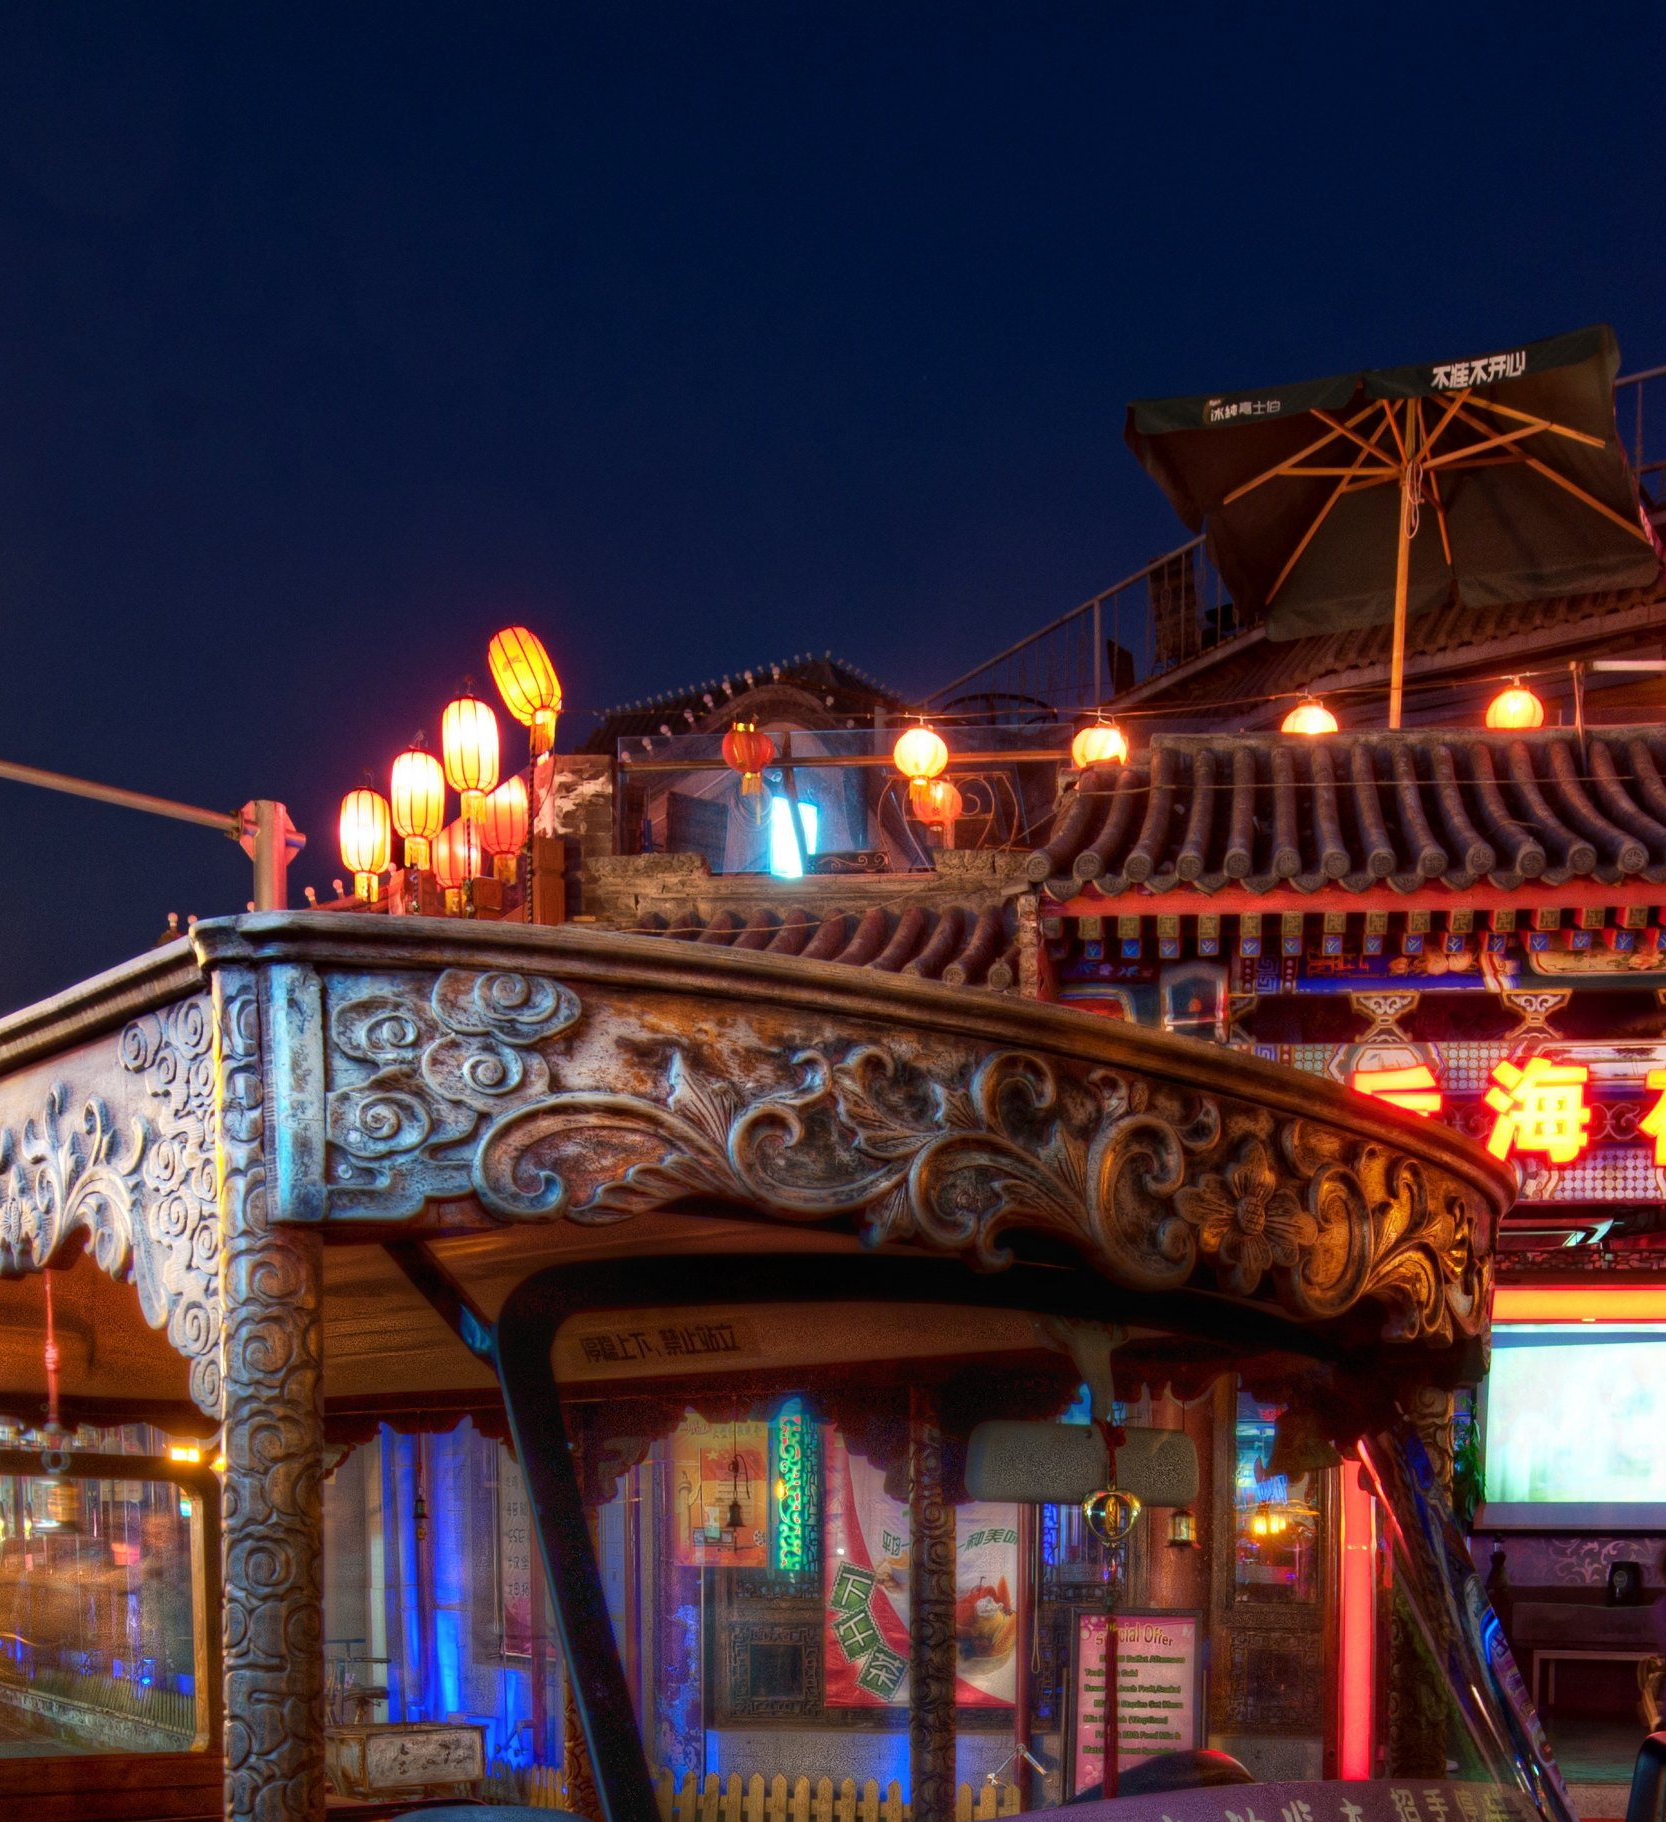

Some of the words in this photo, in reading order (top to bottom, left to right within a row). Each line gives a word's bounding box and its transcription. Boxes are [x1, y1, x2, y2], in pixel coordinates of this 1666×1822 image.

[839, 1572, 904, 1690] 下午茶
[1144, 1624, 1174, 1647] Offer
